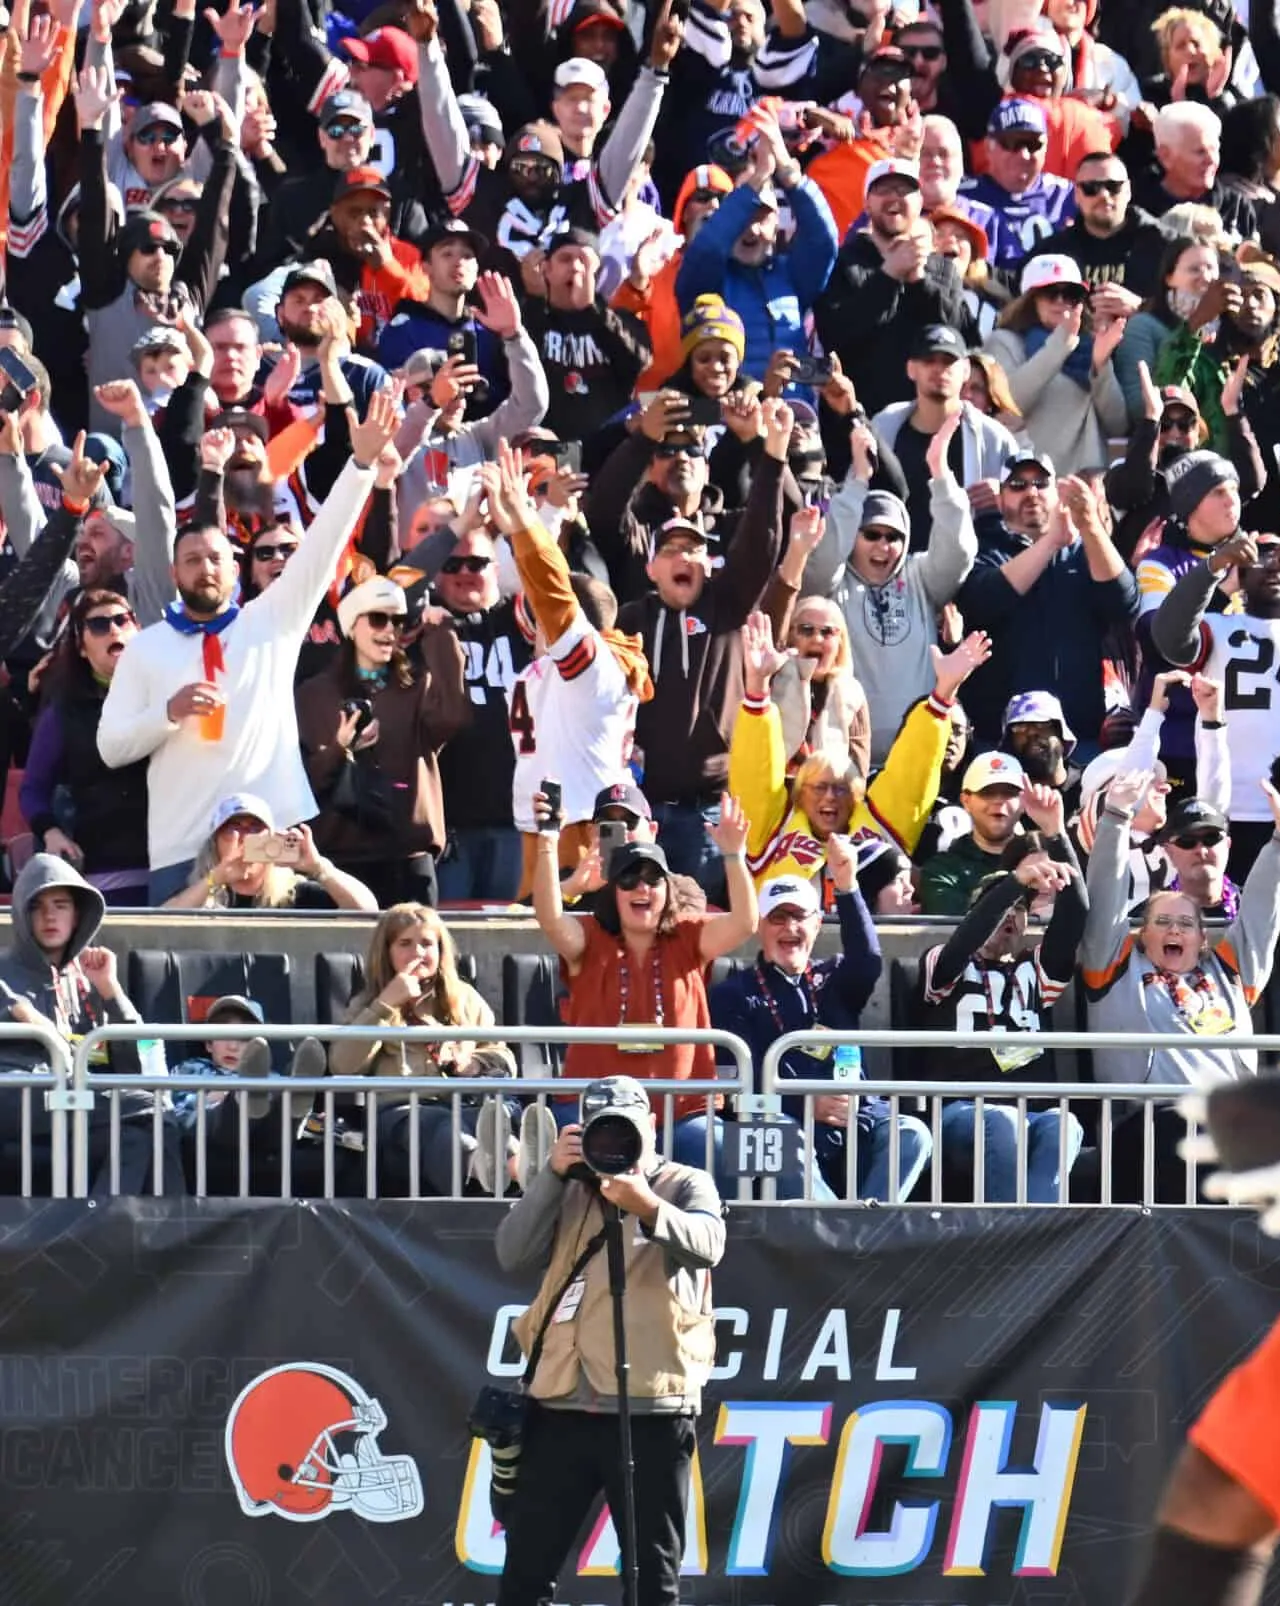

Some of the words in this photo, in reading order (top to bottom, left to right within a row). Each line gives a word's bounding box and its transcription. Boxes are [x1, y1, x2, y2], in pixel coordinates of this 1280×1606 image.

[509, 679, 535, 755] 4
[954, 960, 1039, 1032] 24
[738, 1127, 782, 1172] F13
[486, 1304, 918, 1377] OCIAL
